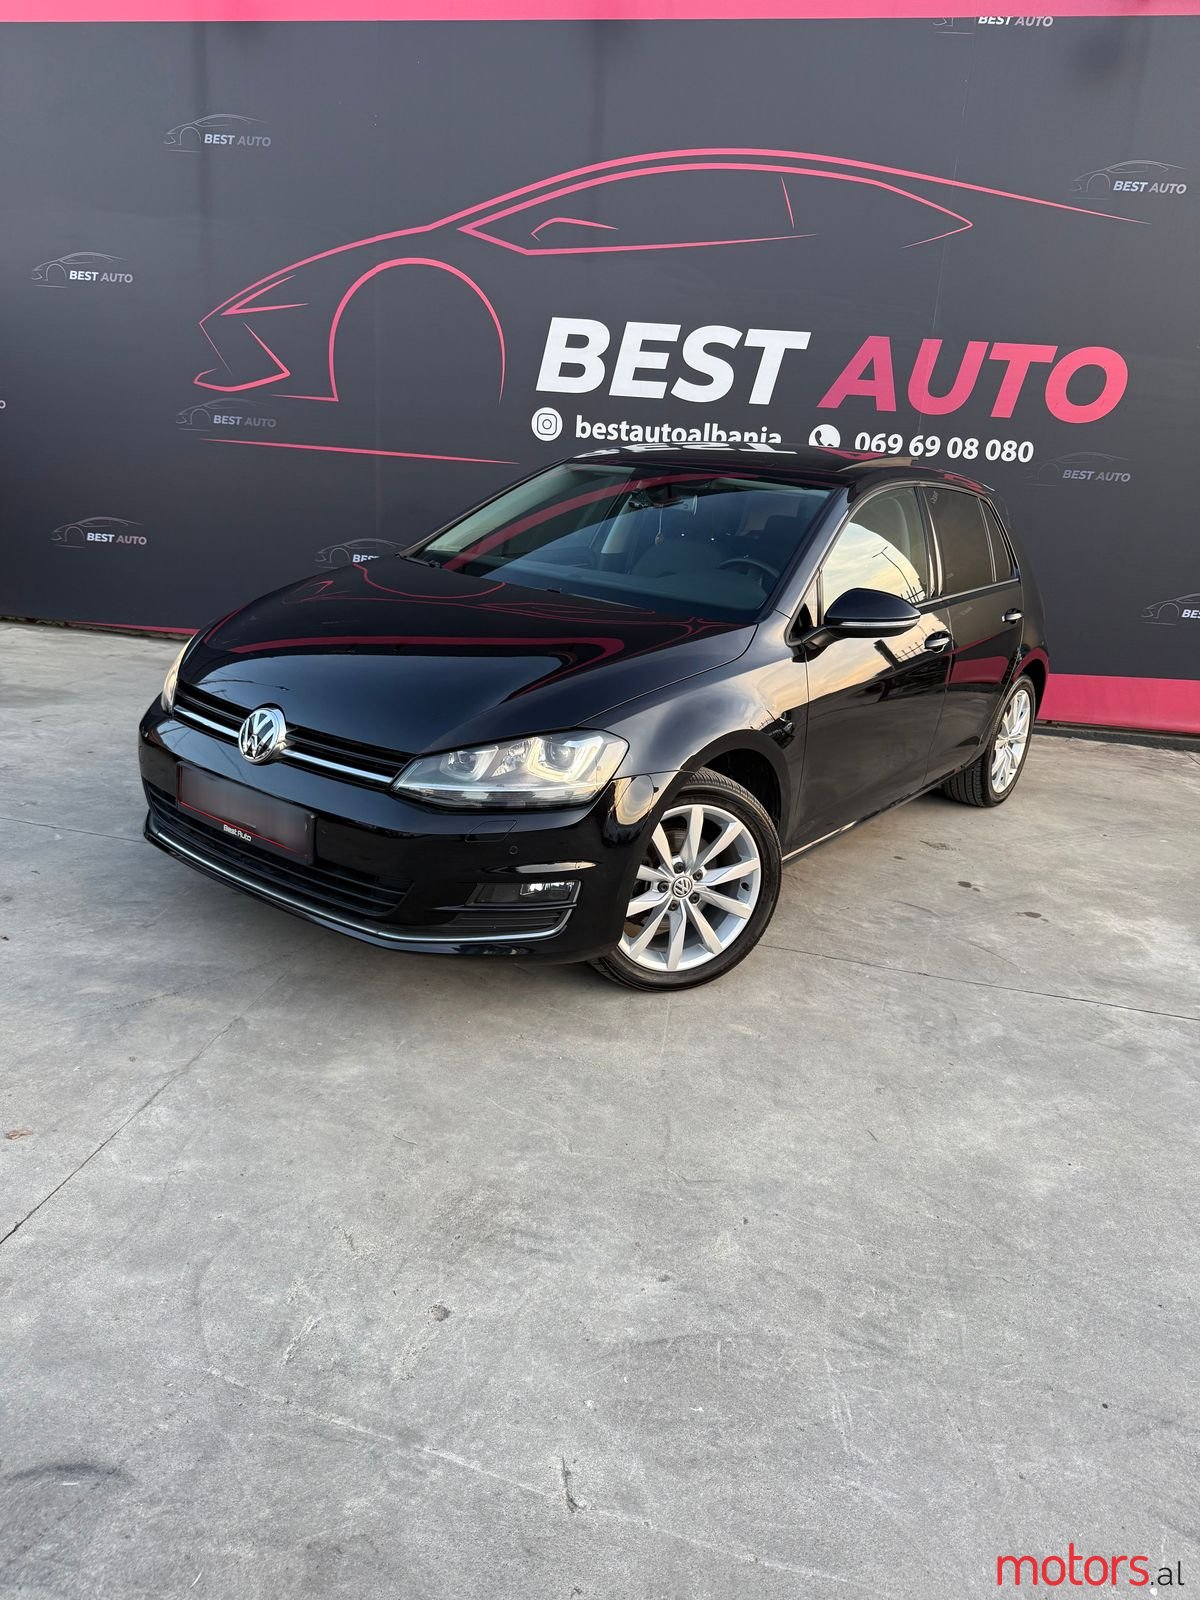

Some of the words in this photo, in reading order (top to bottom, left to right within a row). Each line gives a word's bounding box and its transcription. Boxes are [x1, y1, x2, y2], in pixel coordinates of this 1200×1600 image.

[978, 16, 1014, 26] BEST
[1014, 16, 1054, 28] AUTO
[204, 133, 235, 145] BEST
[237, 136, 272, 147] AUTO
[1113, 181, 1148, 193] BEST
[1149, 183, 1187, 195] AUTO
[69, 270, 99, 281] BEST
[101, 273, 134, 284] AUTO
[536, 317, 811, 405] BEST
[816, 336, 1128, 424] AUTO
[213, 414, 242, 426] BEST
[244, 418, 277, 428] AUTO
[855, 432, 903, 454] 069
[908, 435, 941, 457] 69
[947, 436, 979, 460] 08
[985, 439, 1034, 463] 080
[1062, 469, 1095, 481] BEST
[1095, 472, 1131, 483] AUTO
[86, 532, 115, 543] BEST
[116, 535, 148, 546] AUTO
[352, 554, 380, 564] BE
[1181, 609, 1200, 619] BE
[223, 824, 237, 836] Best
[237, 830, 252, 842] Auto
